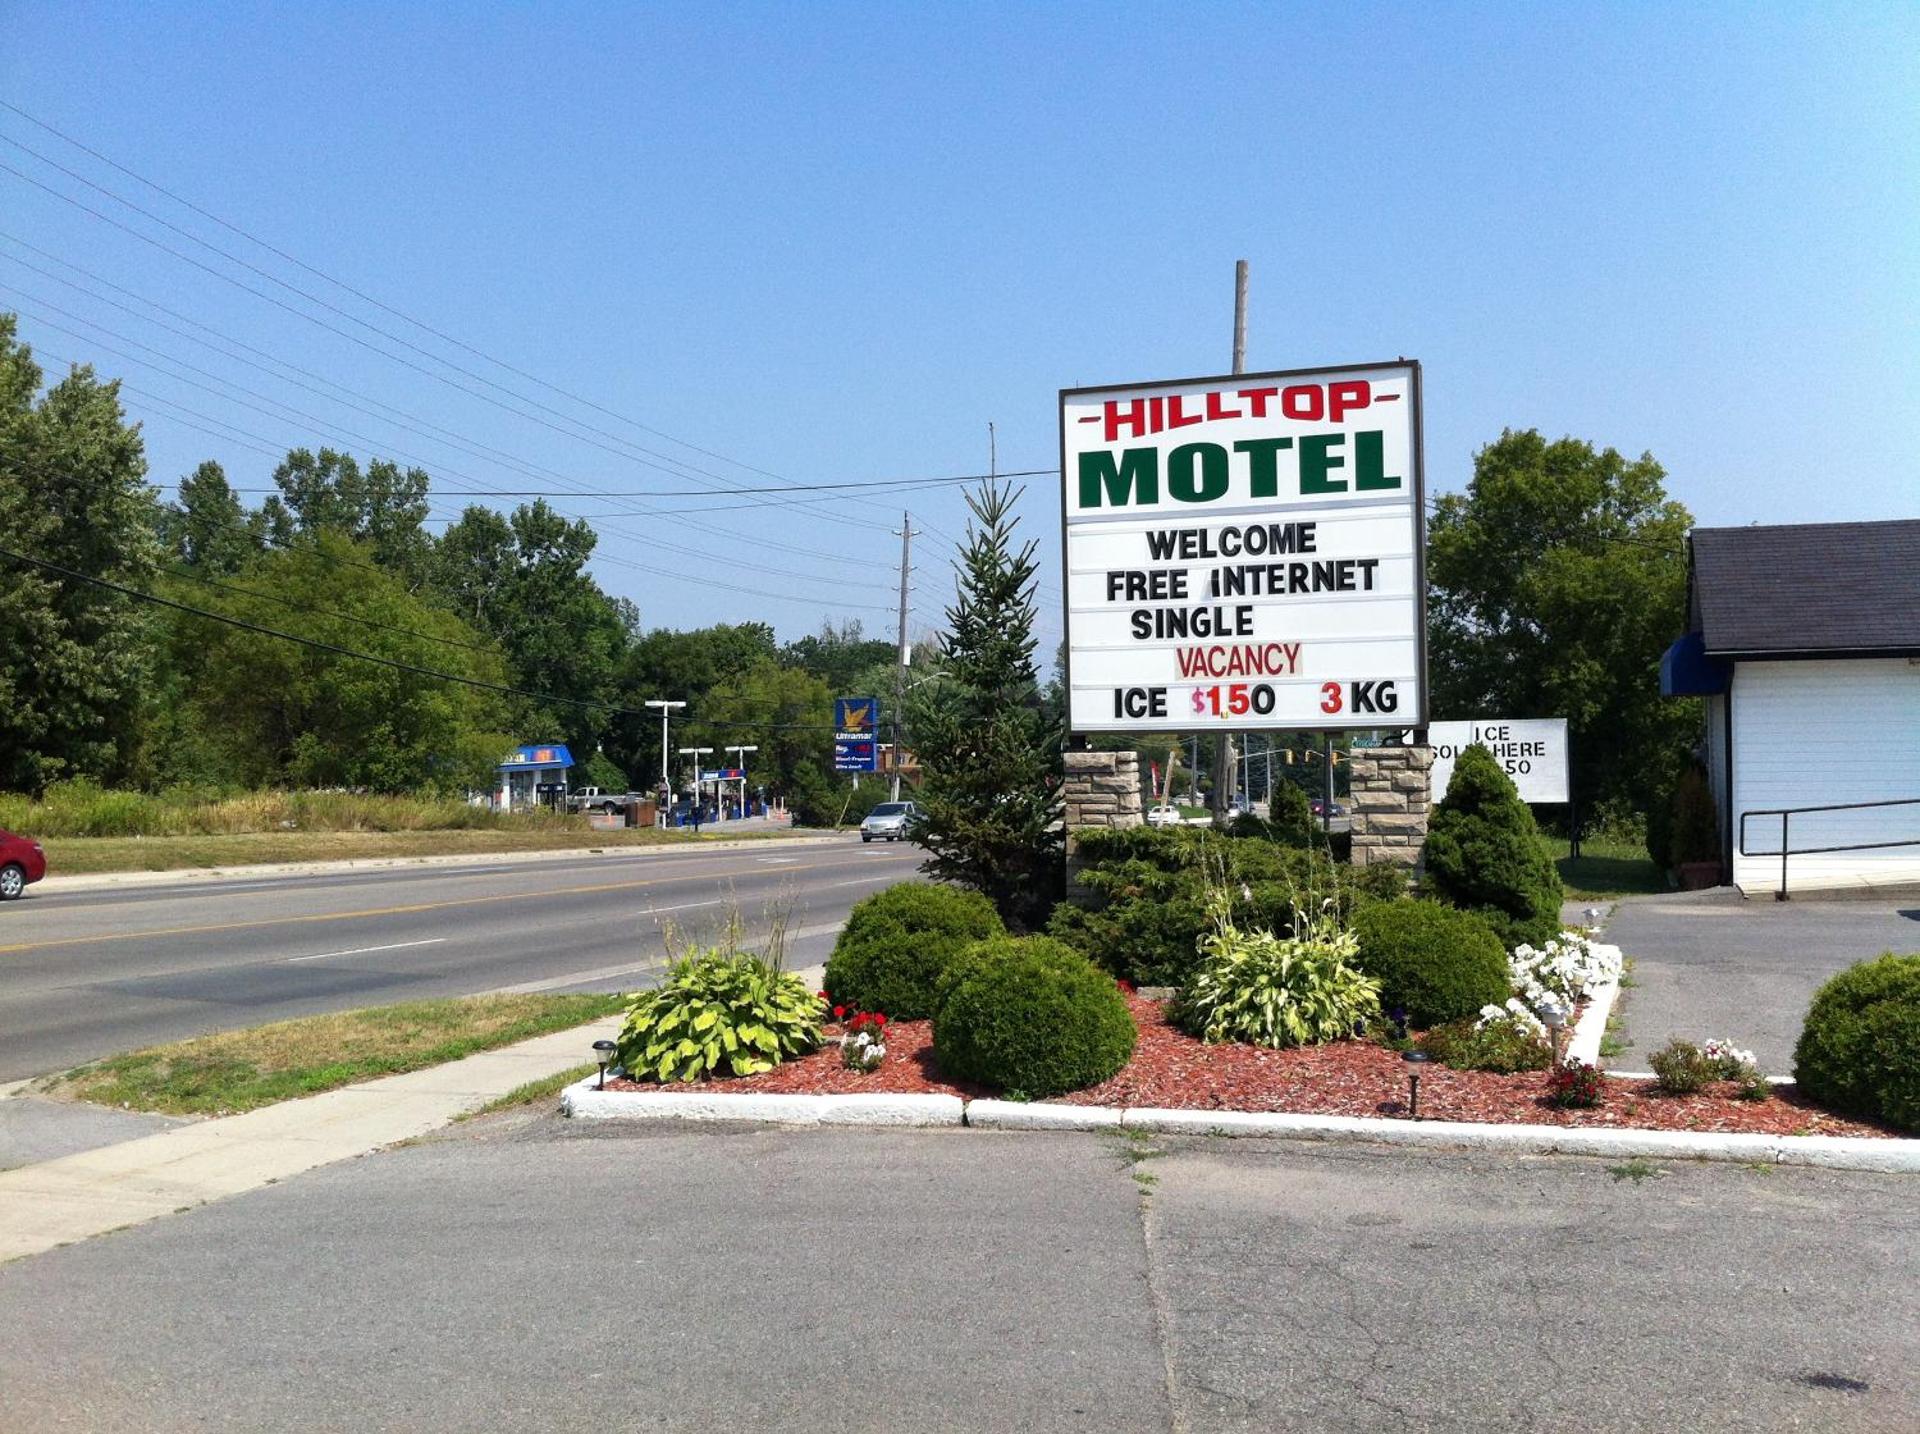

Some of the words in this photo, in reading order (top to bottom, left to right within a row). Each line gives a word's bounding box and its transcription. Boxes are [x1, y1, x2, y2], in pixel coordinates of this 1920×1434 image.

[1078, 430, 1402, 508] MOTEL
[1146, 522, 1316, 560] WELCOME
[1107, 569, 1188, 601] FREE
[1211, 559, 1378, 597] INTERNET
[1131, 605, 1253, 639] SINGLE
[1177, 643, 1300, 678] VACANCY
[1114, 687, 1167, 718] ICE
[1321, 682, 1342, 714] 3
[1352, 681, 1397, 713] KG
[1431, 744, 1468, 759] SOL
[1493, 742, 1545, 757] HERE
[1475, 726, 1510, 741] ICE
